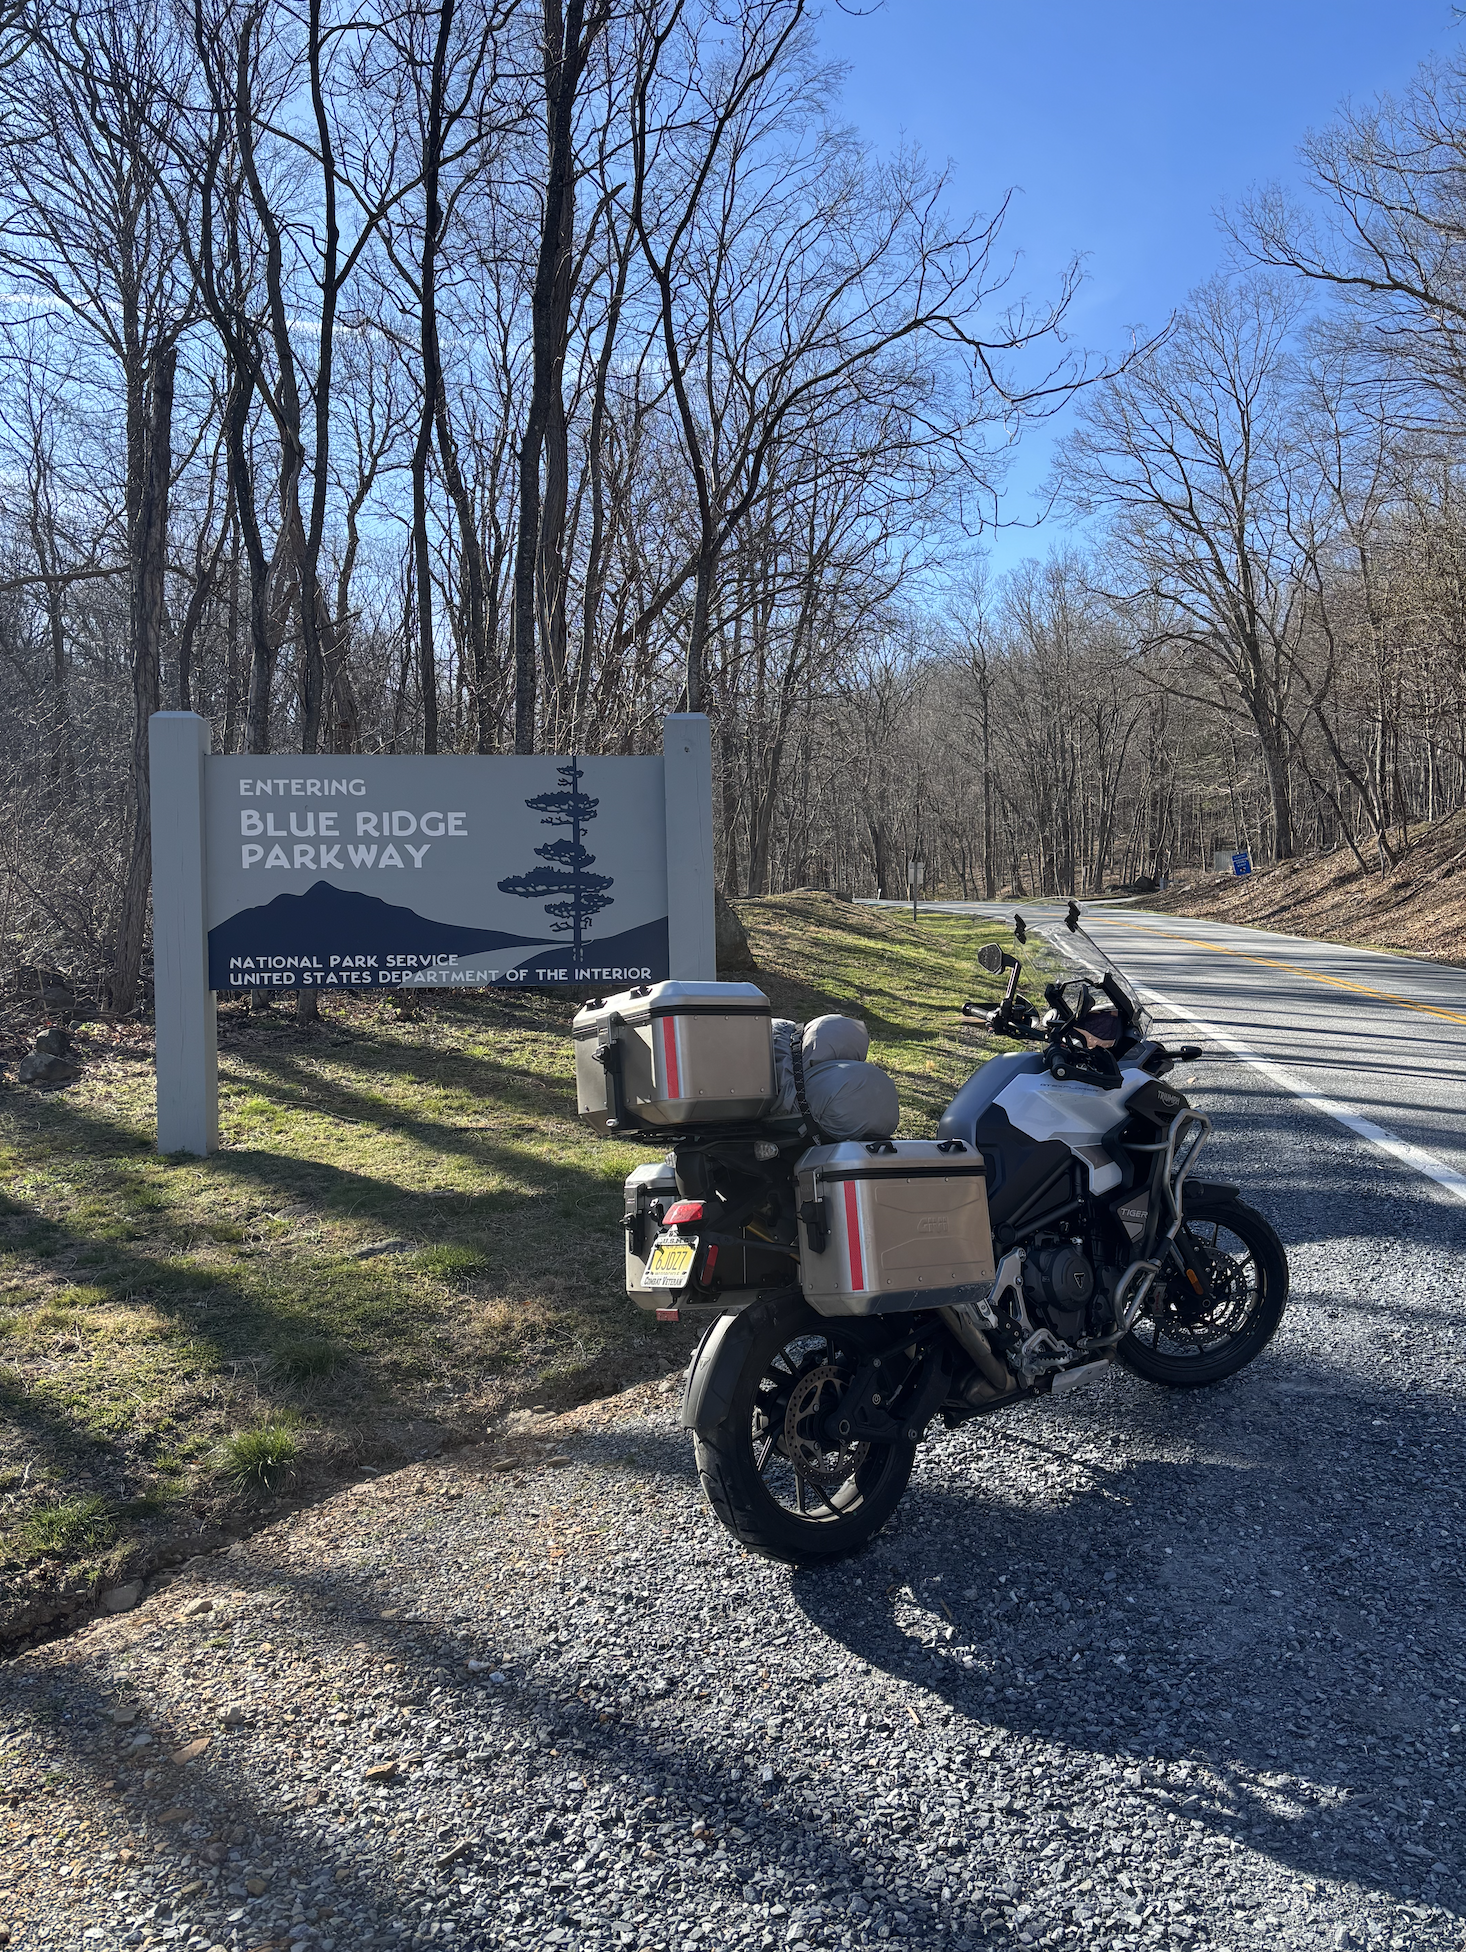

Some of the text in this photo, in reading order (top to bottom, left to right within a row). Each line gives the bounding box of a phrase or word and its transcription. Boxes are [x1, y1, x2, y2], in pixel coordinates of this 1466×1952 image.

[239, 779, 367, 797] ENTERING
[240, 809, 468, 837] BLUE RIDGE
[241, 843, 432, 870] PARKWAY
[229, 953, 459, 969] NATIONAL PARK SERVICE
[229, 967, 652, 986] UNITED STATES DEPARTMENT OF THE INTERIOR
[1157, 1090, 1180, 1106] TRIUMPH
[1120, 1207, 1149, 1219] TIGER
